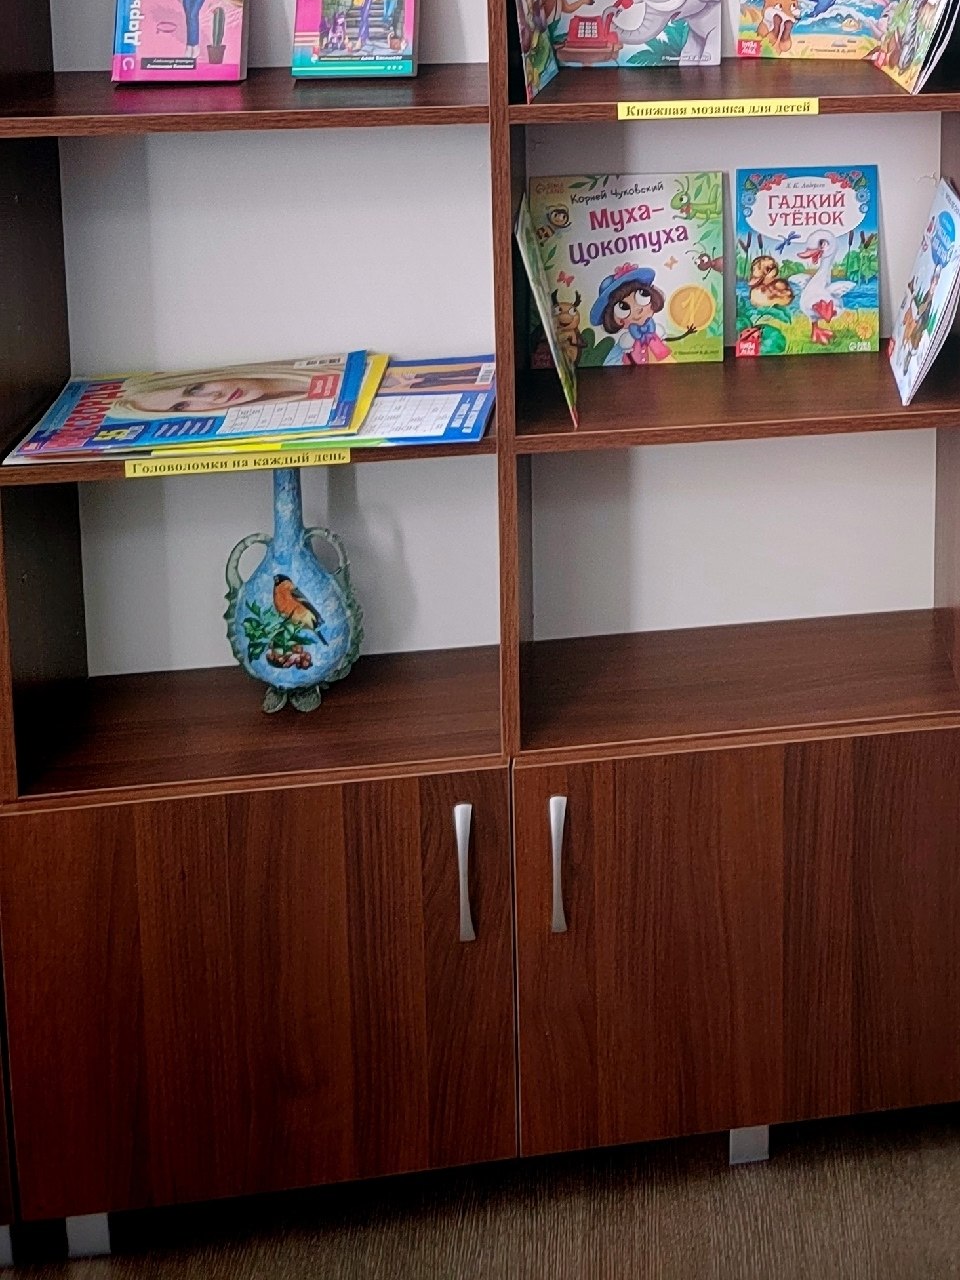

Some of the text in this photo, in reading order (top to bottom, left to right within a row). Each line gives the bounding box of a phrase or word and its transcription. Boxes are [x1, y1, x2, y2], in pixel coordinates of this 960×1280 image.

[626, 101, 811, 117] Книжная мозаика для детей
[570, 181, 664, 205] Корней Чуковский
[768, 191, 846, 210] ГАДКИЙ
[589, 203, 665, 232] Муха-
[768, 210, 845, 227] УТЁНОК
[569, 225, 689, 266] Цокотуха
[132, 452, 346, 474] Головоломки на каждый день
